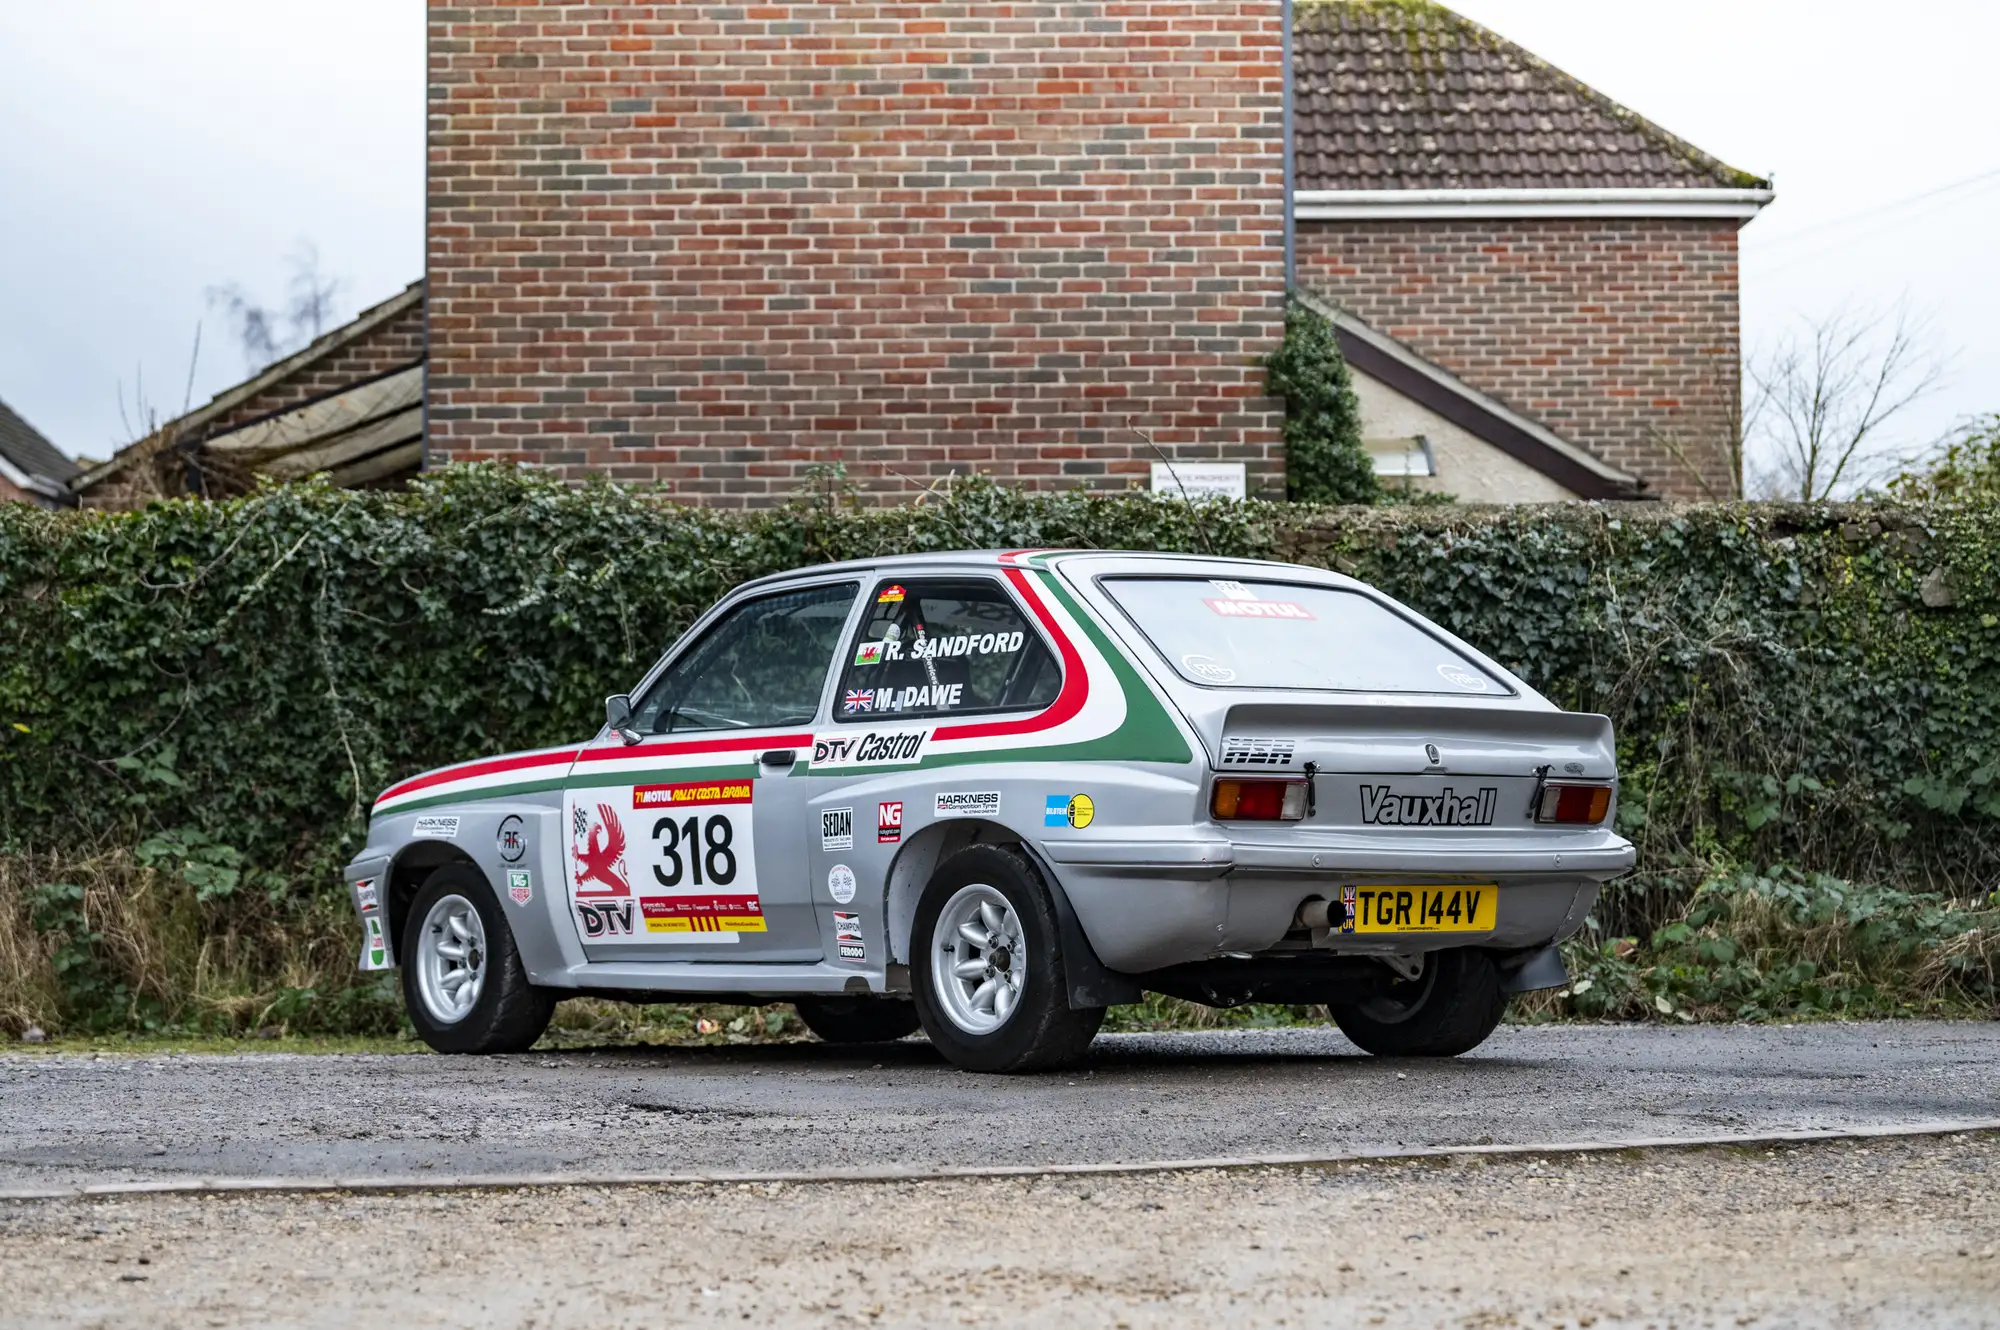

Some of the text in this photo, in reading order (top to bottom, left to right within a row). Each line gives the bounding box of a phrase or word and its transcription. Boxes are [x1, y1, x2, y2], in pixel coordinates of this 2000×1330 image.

[1213, 600, 1310, 617] MOTUL
[885, 641, 904, 661] R.
[910, 631, 1024, 659] SANDFORD
[875, 683, 963, 709] M. DAWE
[812, 731, 927, 763] DTV Castrol
[643, 789, 672, 803] MOTUL
[672, 788, 697, 801] RALLY
[697, 787, 721, 800] COSTA
[721, 785, 750, 798] BRAVA
[937, 794, 998, 804] HARKNESS
[1360, 785, 1497, 826] Vauxhall
[418, 818, 458, 826] HARKNESS
[823, 811, 852, 837] SEDAN
[879, 804, 902, 826] NG
[652, 814, 737, 887] 318
[576, 900, 634, 937] DTV
[1359, 890, 1481, 925] TGR 144V
[837, 921, 860, 932] CHAMPION
[840, 946, 864, 958] FERODO
